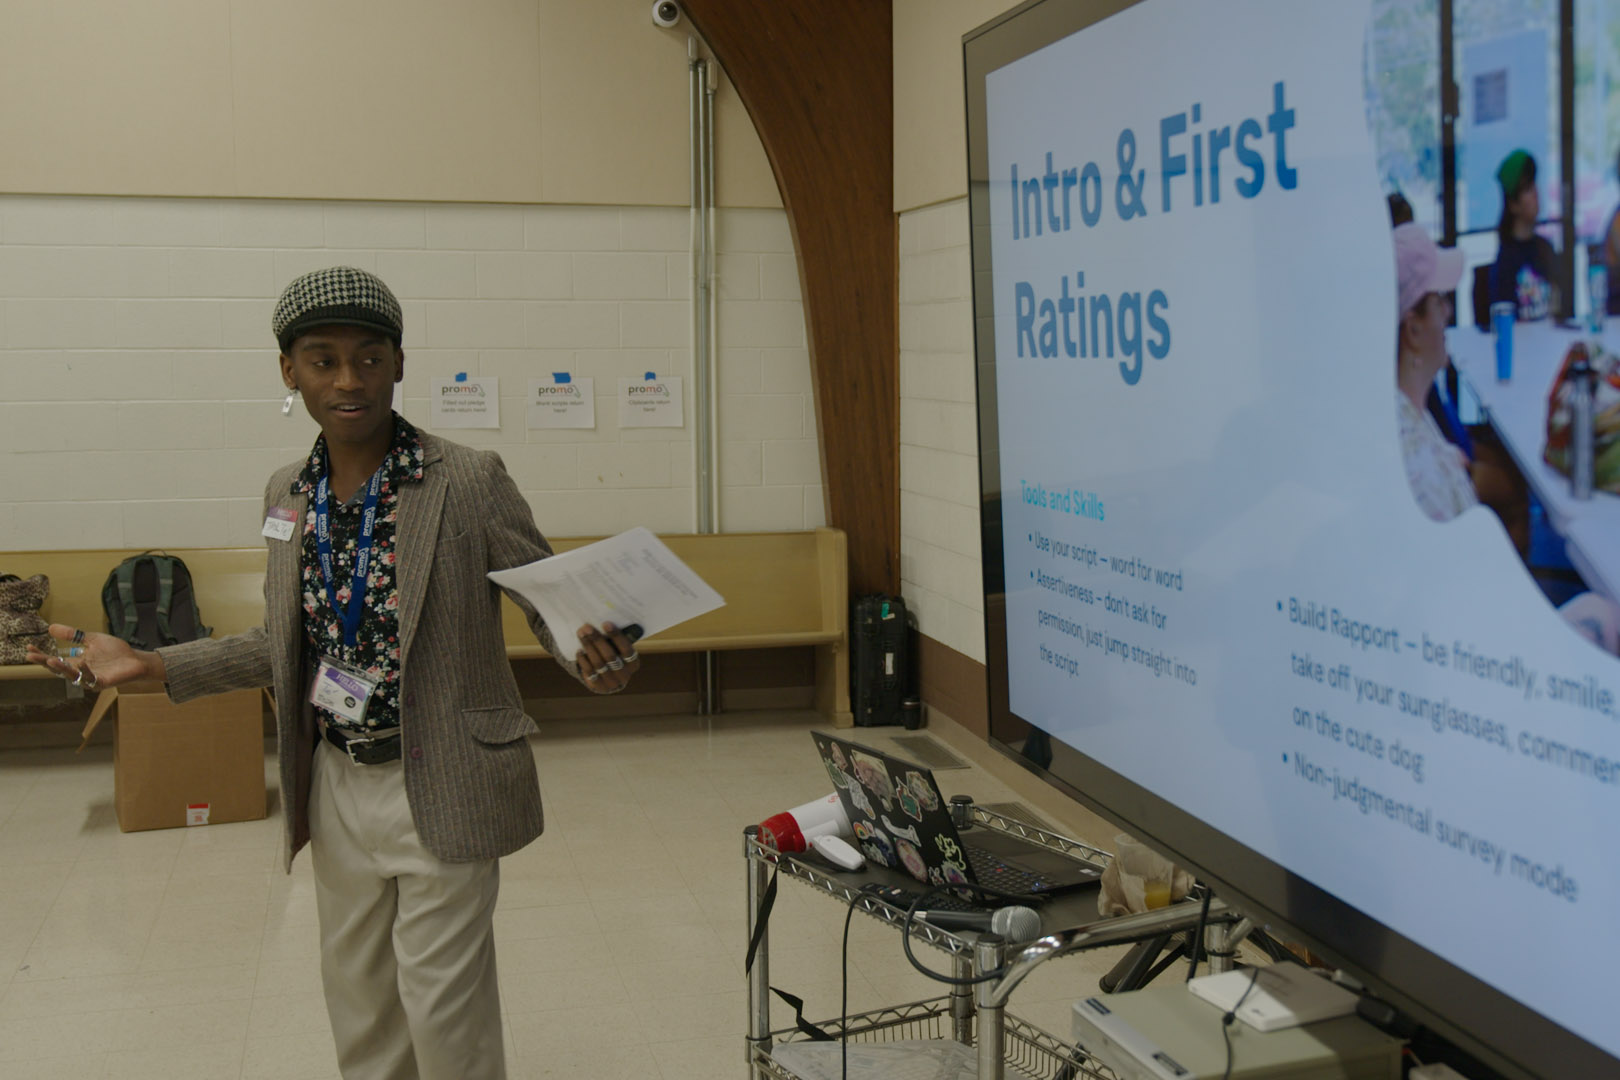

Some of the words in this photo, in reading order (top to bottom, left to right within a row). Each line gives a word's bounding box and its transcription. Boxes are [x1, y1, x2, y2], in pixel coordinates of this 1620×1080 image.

[1011, 151, 1102, 240] Intro
[1115, 128, 1147, 221] &
[1160, 81, 1298, 213] First
[1015, 271, 1171, 386] Ratings
[442, 386, 478, 396] promo
[538, 386, 574, 397] promo
[628, 386, 663, 397] promo
[319, 513, 328, 538] promo
[363, 511, 373, 536] promo
[1021, 479, 1047, 508] Tools
[1050, 487, 1071, 513] and
[1073, 489, 1105, 521] Skills
[357, 552, 366, 577] promo
[1034, 531, 1050, 552] Use
[1051, 540, 1070, 559] your
[1072, 544, 1097, 569] script
[1110, 555, 1135, 578] word
[1137, 558, 1152, 582] for
[1155, 567, 1183, 592] word
[1036, 568, 1094, 605] Assertiveness
[1104, 591, 1130, 618] don't
[1131, 601, 1149, 625] ask
[1151, 604, 1167, 630] for
[1038, 608, 1084, 643] permission,
[1085, 624, 1103, 648] just
[1104, 631, 1129, 661] jump
[1131, 644, 1171, 678] straight
[1173, 658, 1197, 687] into
[1039, 643, 1053, 664] the
[1054, 648, 1079, 679] script
[1289, 597, 1327, 632] Build
[1330, 608, 1400, 653] Rapport
[1421, 632, 1447, 667] be
[1453, 640, 1541, 700] friendly,
[1291, 653, 1324, 683] take
[1327, 664, 1350, 692] off
[1353, 675, 1394, 705] your
[1399, 689, 1514, 752] sunglasses,
[1293, 705, 1312, 728] on
[1315, 709, 1342, 742] the
[1345, 726, 1384, 759] cute
[1388, 738, 1425, 784] dog
[1294, 750, 1432, 836] Non-judgmental
[1435, 818, 1505, 875] survey
[1510, 850, 1580, 903] mode
